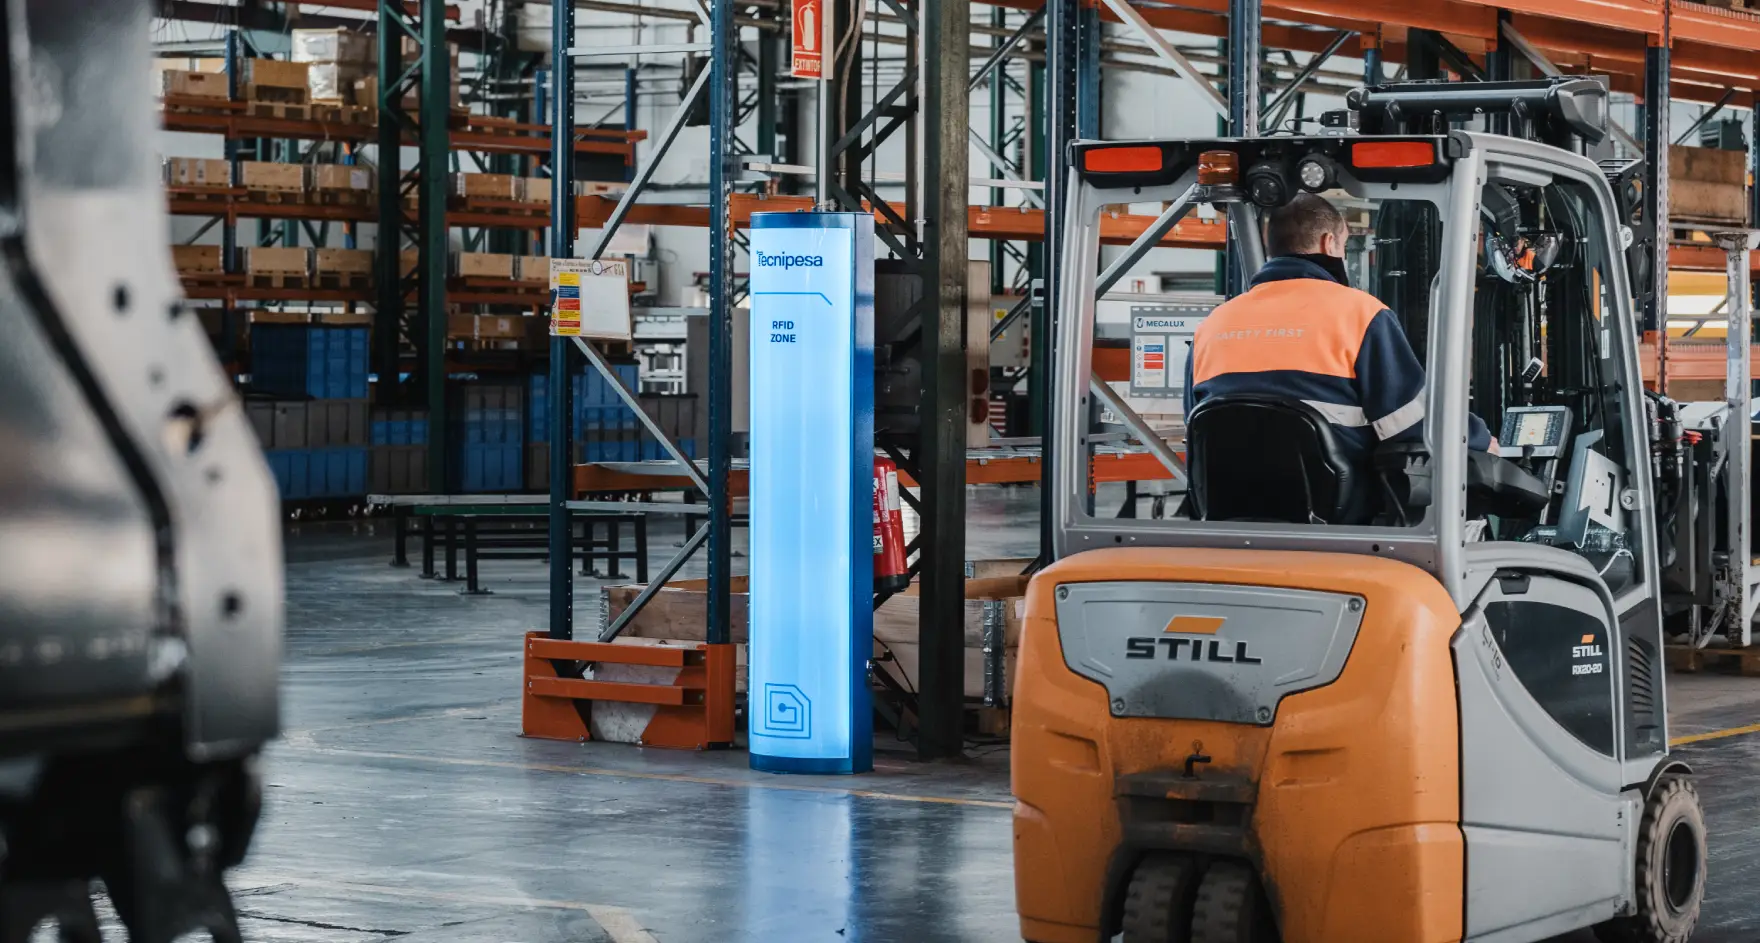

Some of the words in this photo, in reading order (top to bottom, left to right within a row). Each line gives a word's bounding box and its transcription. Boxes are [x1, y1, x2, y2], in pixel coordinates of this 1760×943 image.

[756, 250, 823, 270] Tecnipesa
[772, 320, 795, 330] RFID
[1145, 320, 1185, 328] MECALUX
[770, 333, 797, 343] ZONE
[1215, 328, 1262, 341] SAFETY
[1265, 327, 1306, 339] FIRST
[1125, 637, 1263, 665] STILL
[1572, 644, 1603, 658] STILL
